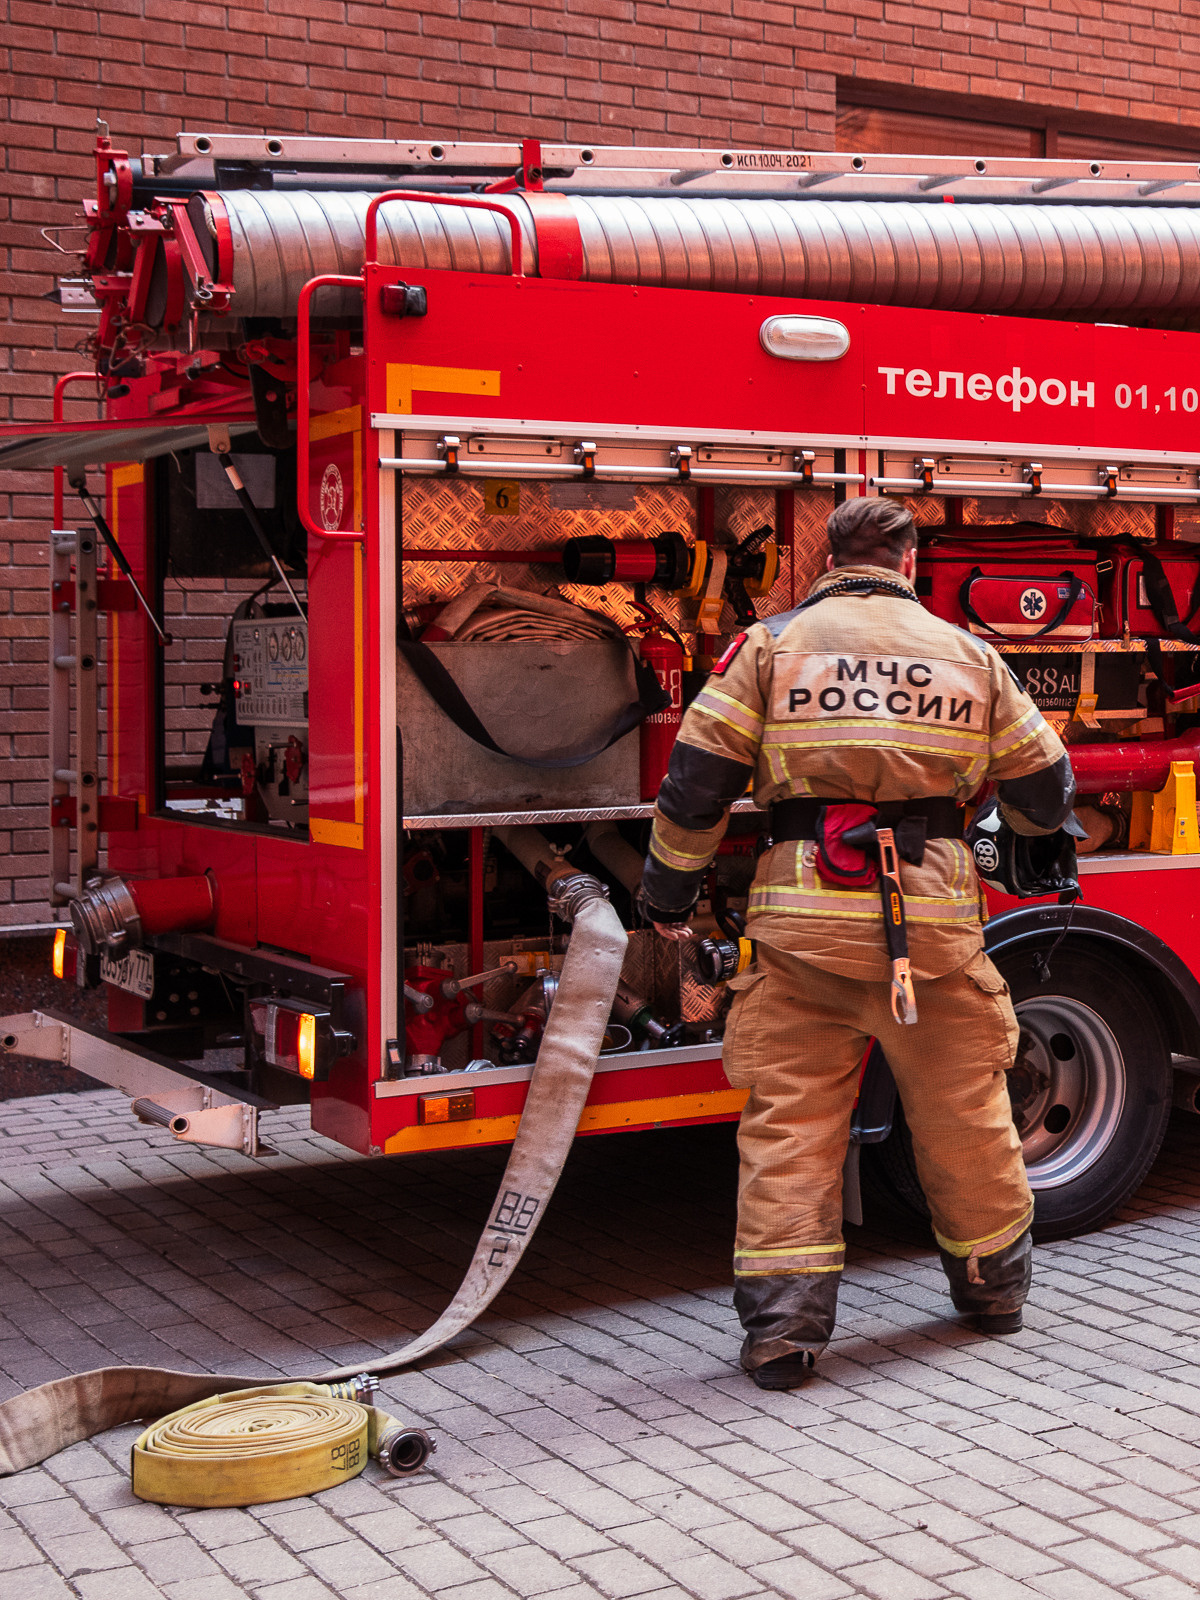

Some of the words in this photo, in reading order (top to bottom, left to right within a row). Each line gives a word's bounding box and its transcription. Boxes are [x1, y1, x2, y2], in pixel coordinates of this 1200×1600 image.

[877, 366, 1095, 412] телефон
[495, 486, 510, 509] 6
[836, 658, 933, 689] МЧС
[788, 686, 974, 724] РОССИИ
[976, 843, 995, 868] 88
[494, 1190, 540, 1230] 88
[487, 1235, 512, 1268] 2
